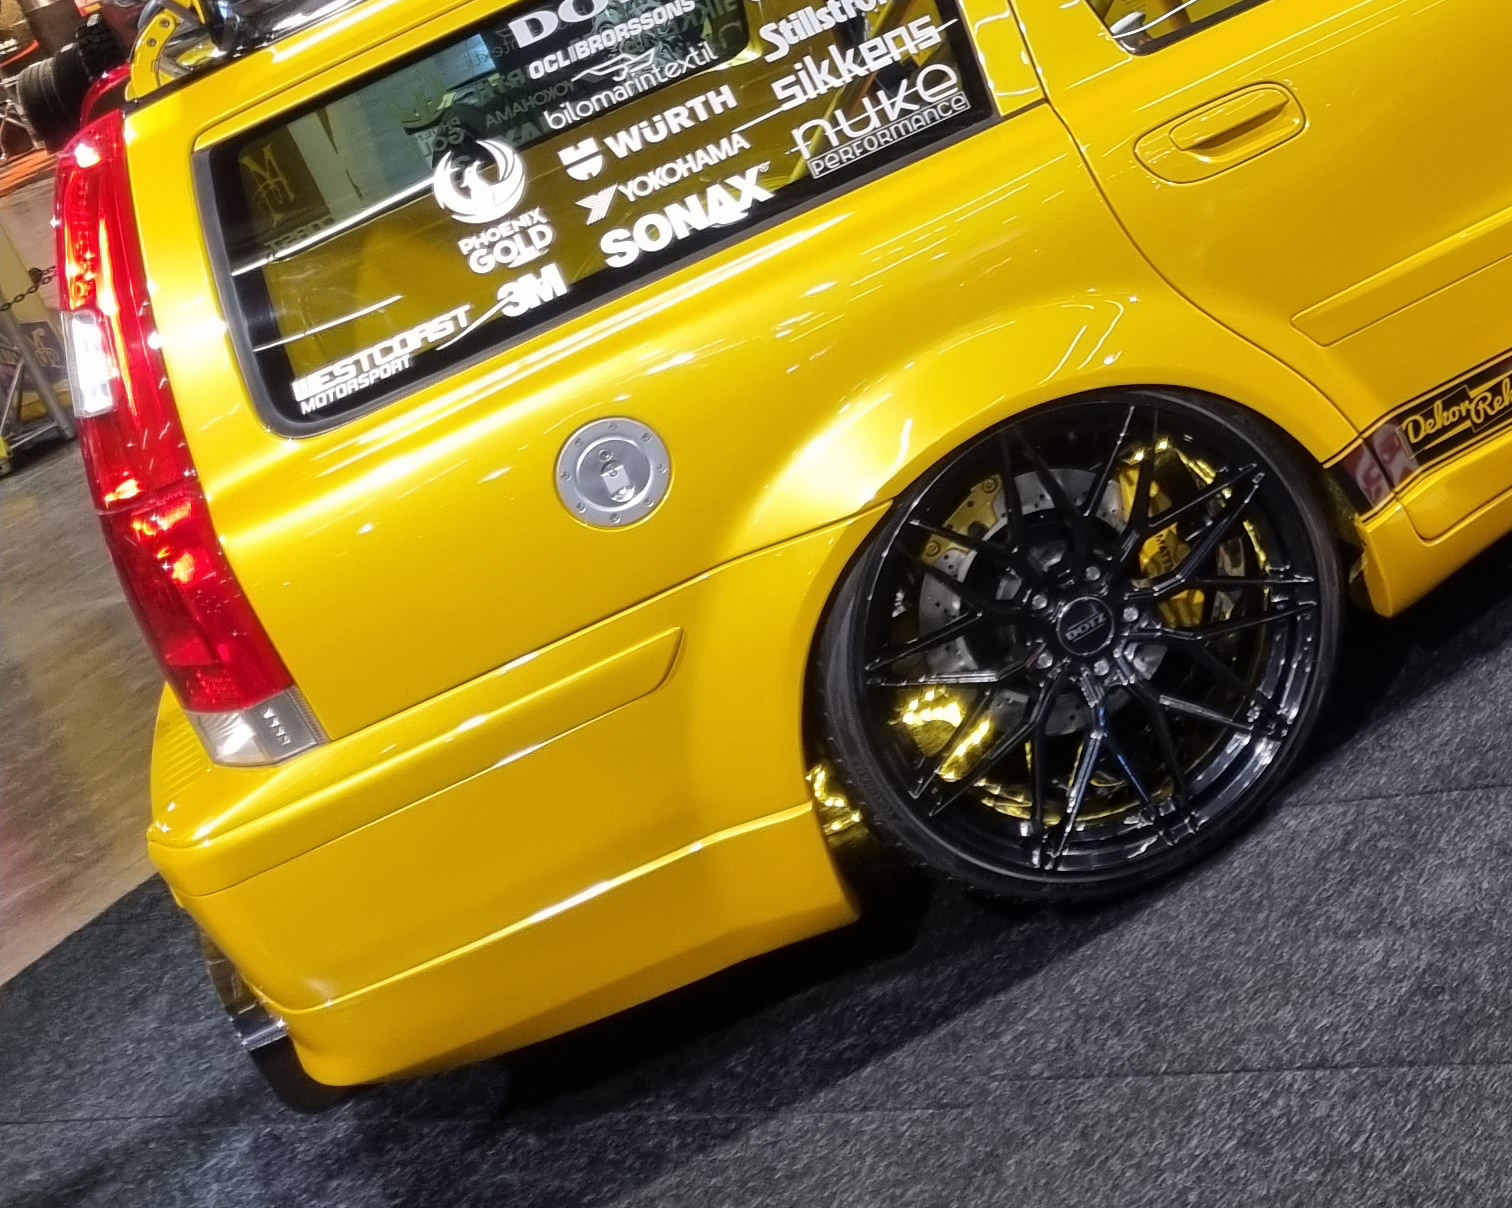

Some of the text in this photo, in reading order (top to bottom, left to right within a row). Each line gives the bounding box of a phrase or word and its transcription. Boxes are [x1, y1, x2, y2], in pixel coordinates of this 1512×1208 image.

[544, 40, 718, 131] bilomarintextil
[771, 15, 944, 111] sikkens
[604, 84, 738, 160] WÜRTH
[790, 63, 958, 160] nuke
[618, 133, 751, 203] YOKOHAMA
[458, 207, 548, 256] PHOENIX
[468, 224, 554, 275] GOLD
[600, 167, 775, 269] SONAX
[496, 262, 569, 318] 3M
[290, 302, 474, 402] WESTCOAST
[300, 354, 411, 415] MOTORSPORT
[1064, 612, 1107, 642] DOTZ
